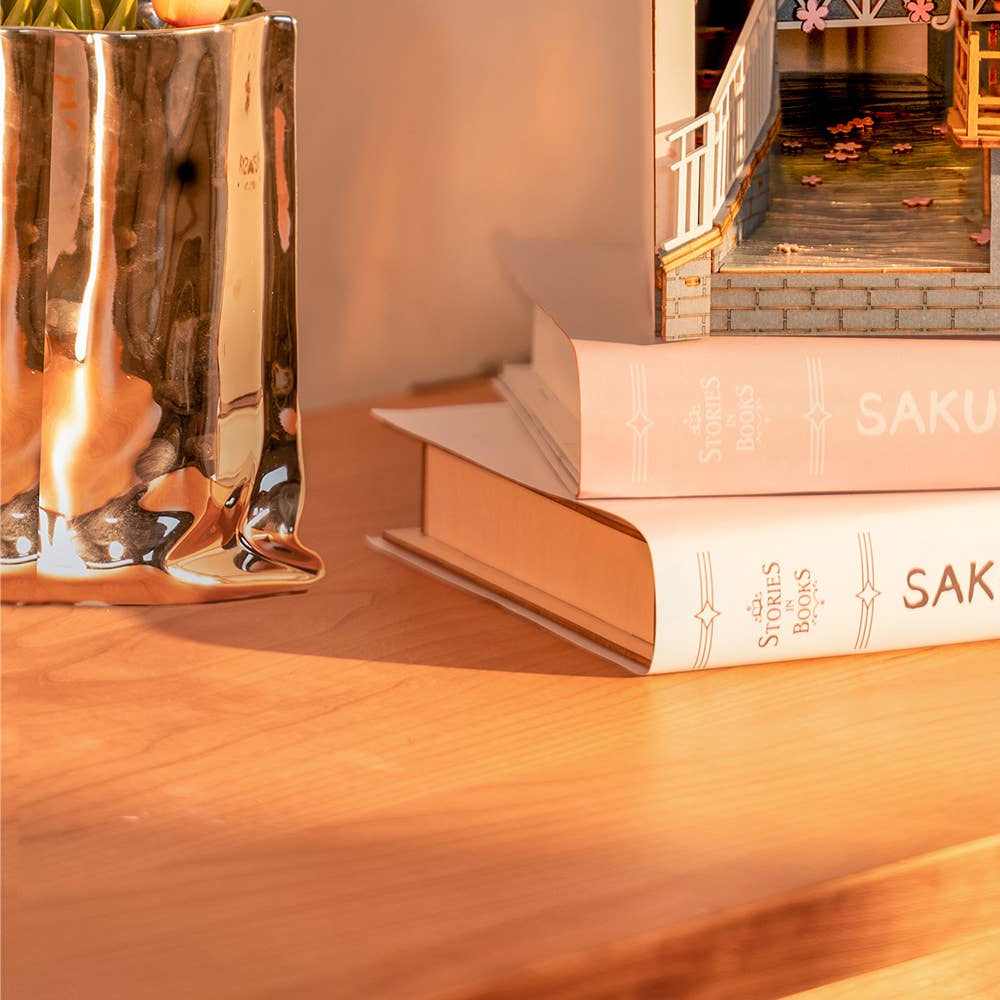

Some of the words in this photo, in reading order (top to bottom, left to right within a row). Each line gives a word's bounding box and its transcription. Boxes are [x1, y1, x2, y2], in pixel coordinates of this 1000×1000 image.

[698, 375, 721, 464] STORIES
[735, 384, 754, 451] BOOKS
[758, 561, 781, 648] STORIES
[785, 599, 795, 612] IN
[792, 568, 812, 635] BOOKS
